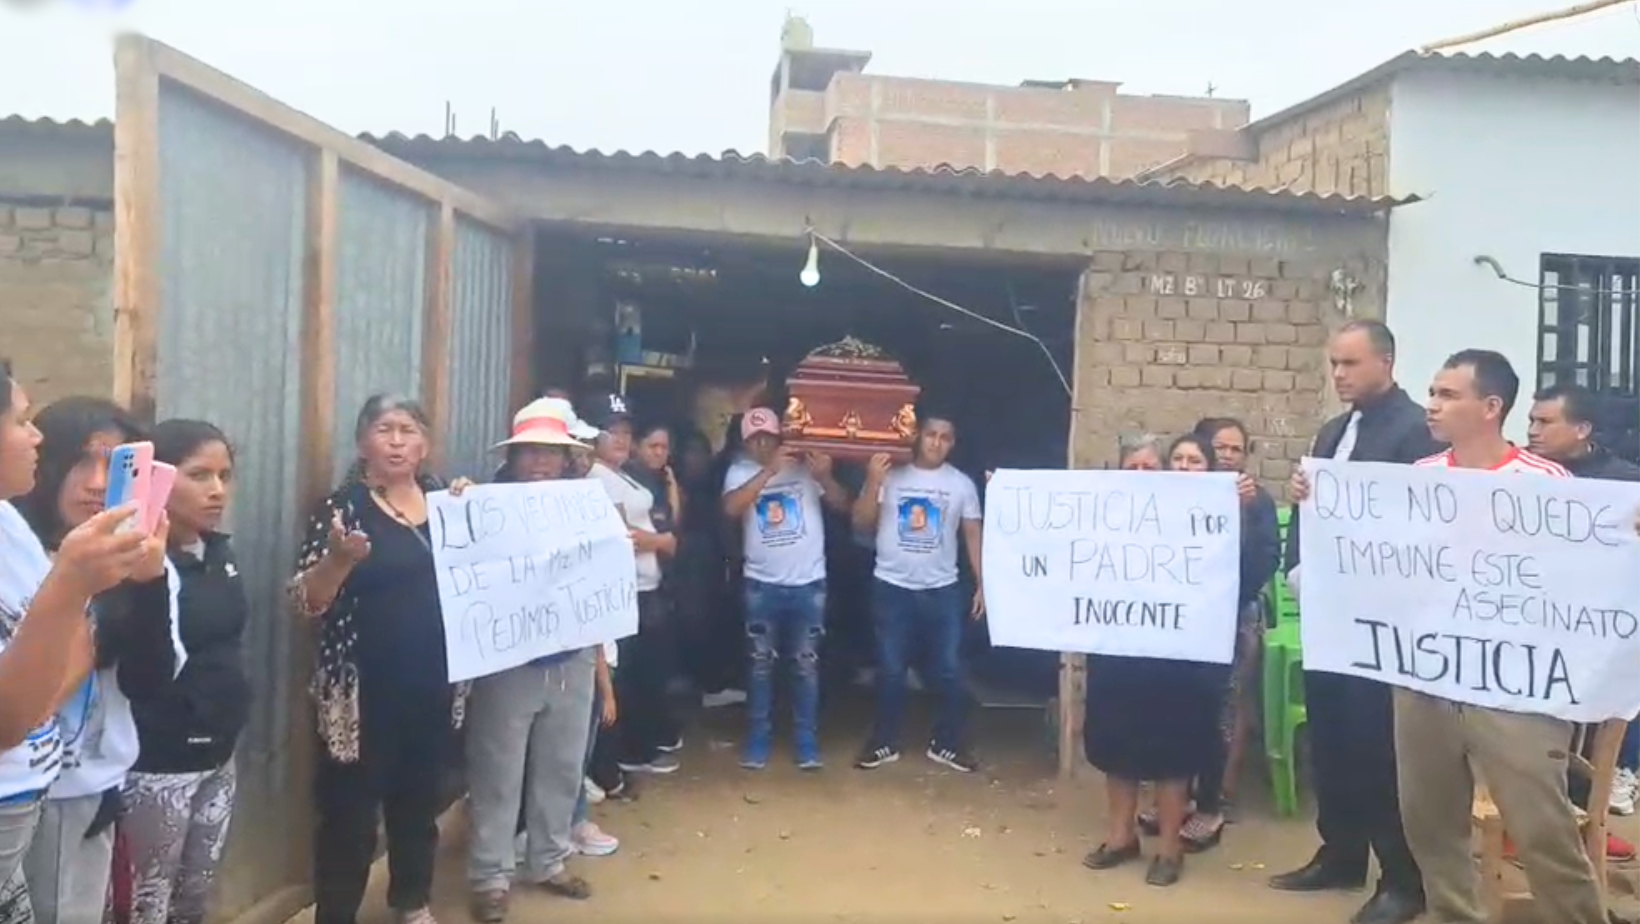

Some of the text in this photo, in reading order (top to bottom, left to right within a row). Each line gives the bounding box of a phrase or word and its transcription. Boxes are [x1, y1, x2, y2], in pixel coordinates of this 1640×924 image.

[1242, 281, 1265, 300] 26
[609, 394, 627, 412] LA
[436, 497, 505, 550] LOS
[998, 486, 1229, 536] JUSTICIA POR
[1314, 469, 1619, 547] QUE NO QUEDE
[449, 563, 491, 597] DE
[509, 555, 536, 584] LA
[1022, 538, 1204, 585] UN PADRE
[1335, 536, 1542, 589] IMPUNE ESTE
[461, 600, 560, 660] PEDIMOS
[1073, 596, 1187, 631] INOCENTE
[1452, 588, 1638, 639] ASECINATO
[1350, 618, 1580, 705] JUSTICIA
